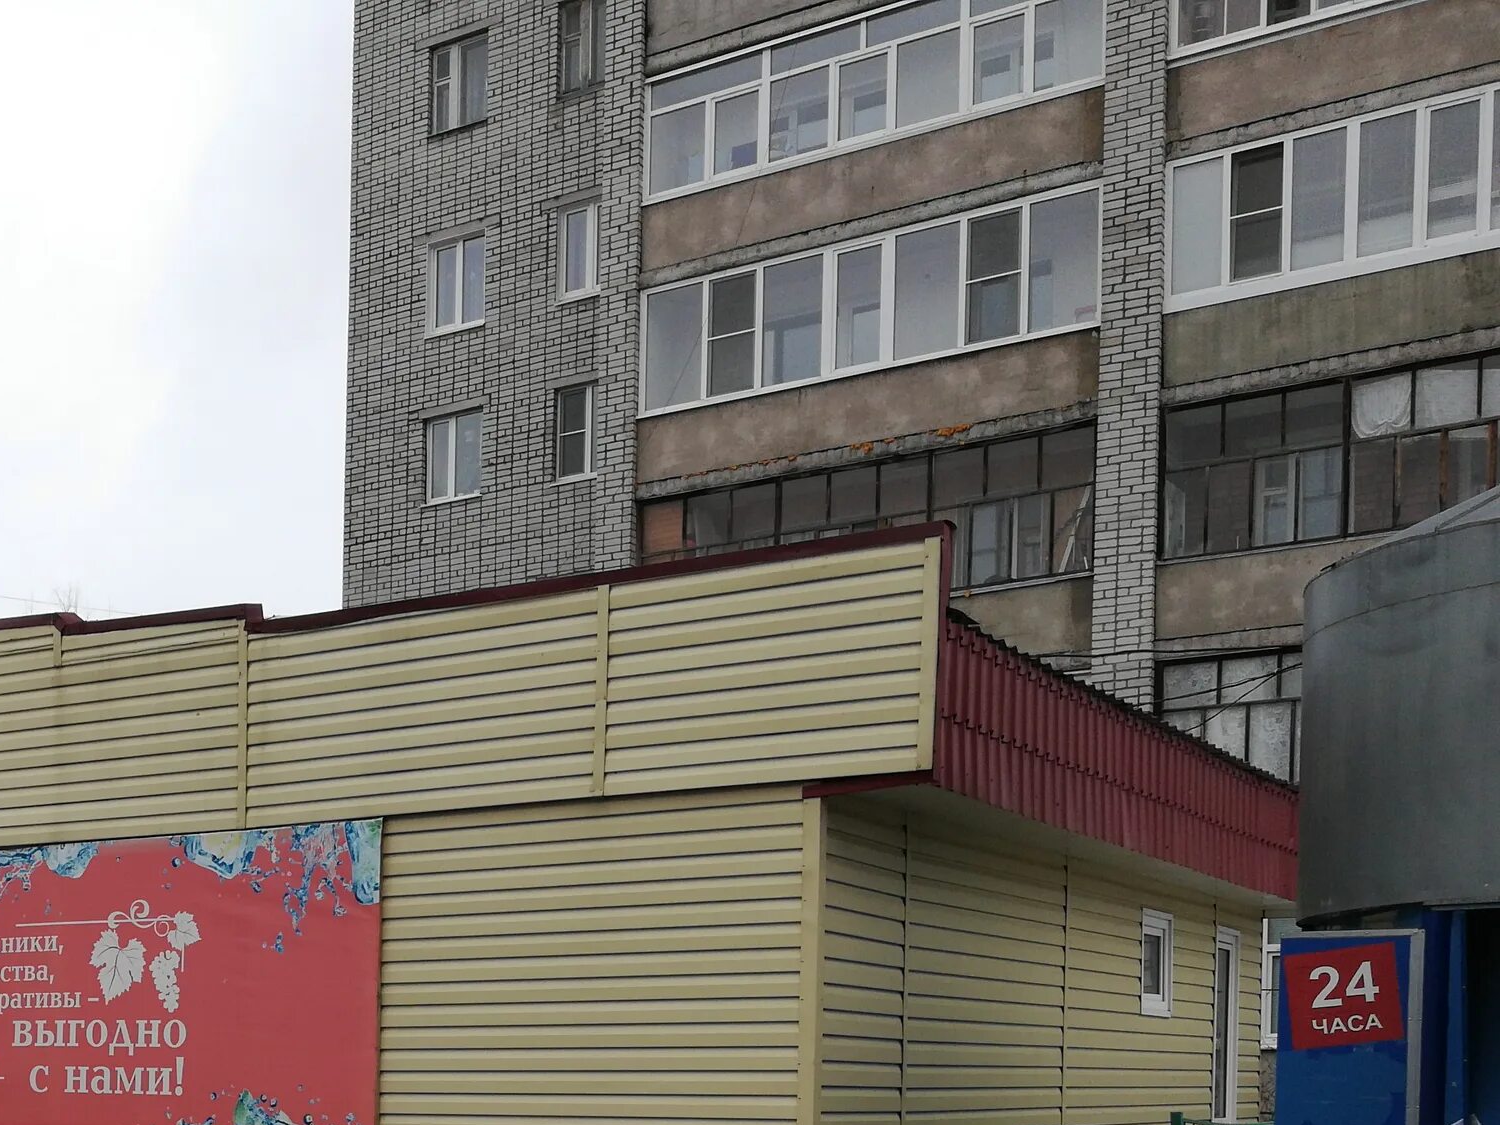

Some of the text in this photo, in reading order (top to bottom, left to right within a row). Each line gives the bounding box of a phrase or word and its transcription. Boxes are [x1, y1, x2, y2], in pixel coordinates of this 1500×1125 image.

[1309, 960, 1380, 1009] 24
[1311, 1013, 1384, 1035] ЧАСА
[29, 1056, 185, 1097] с нами!
